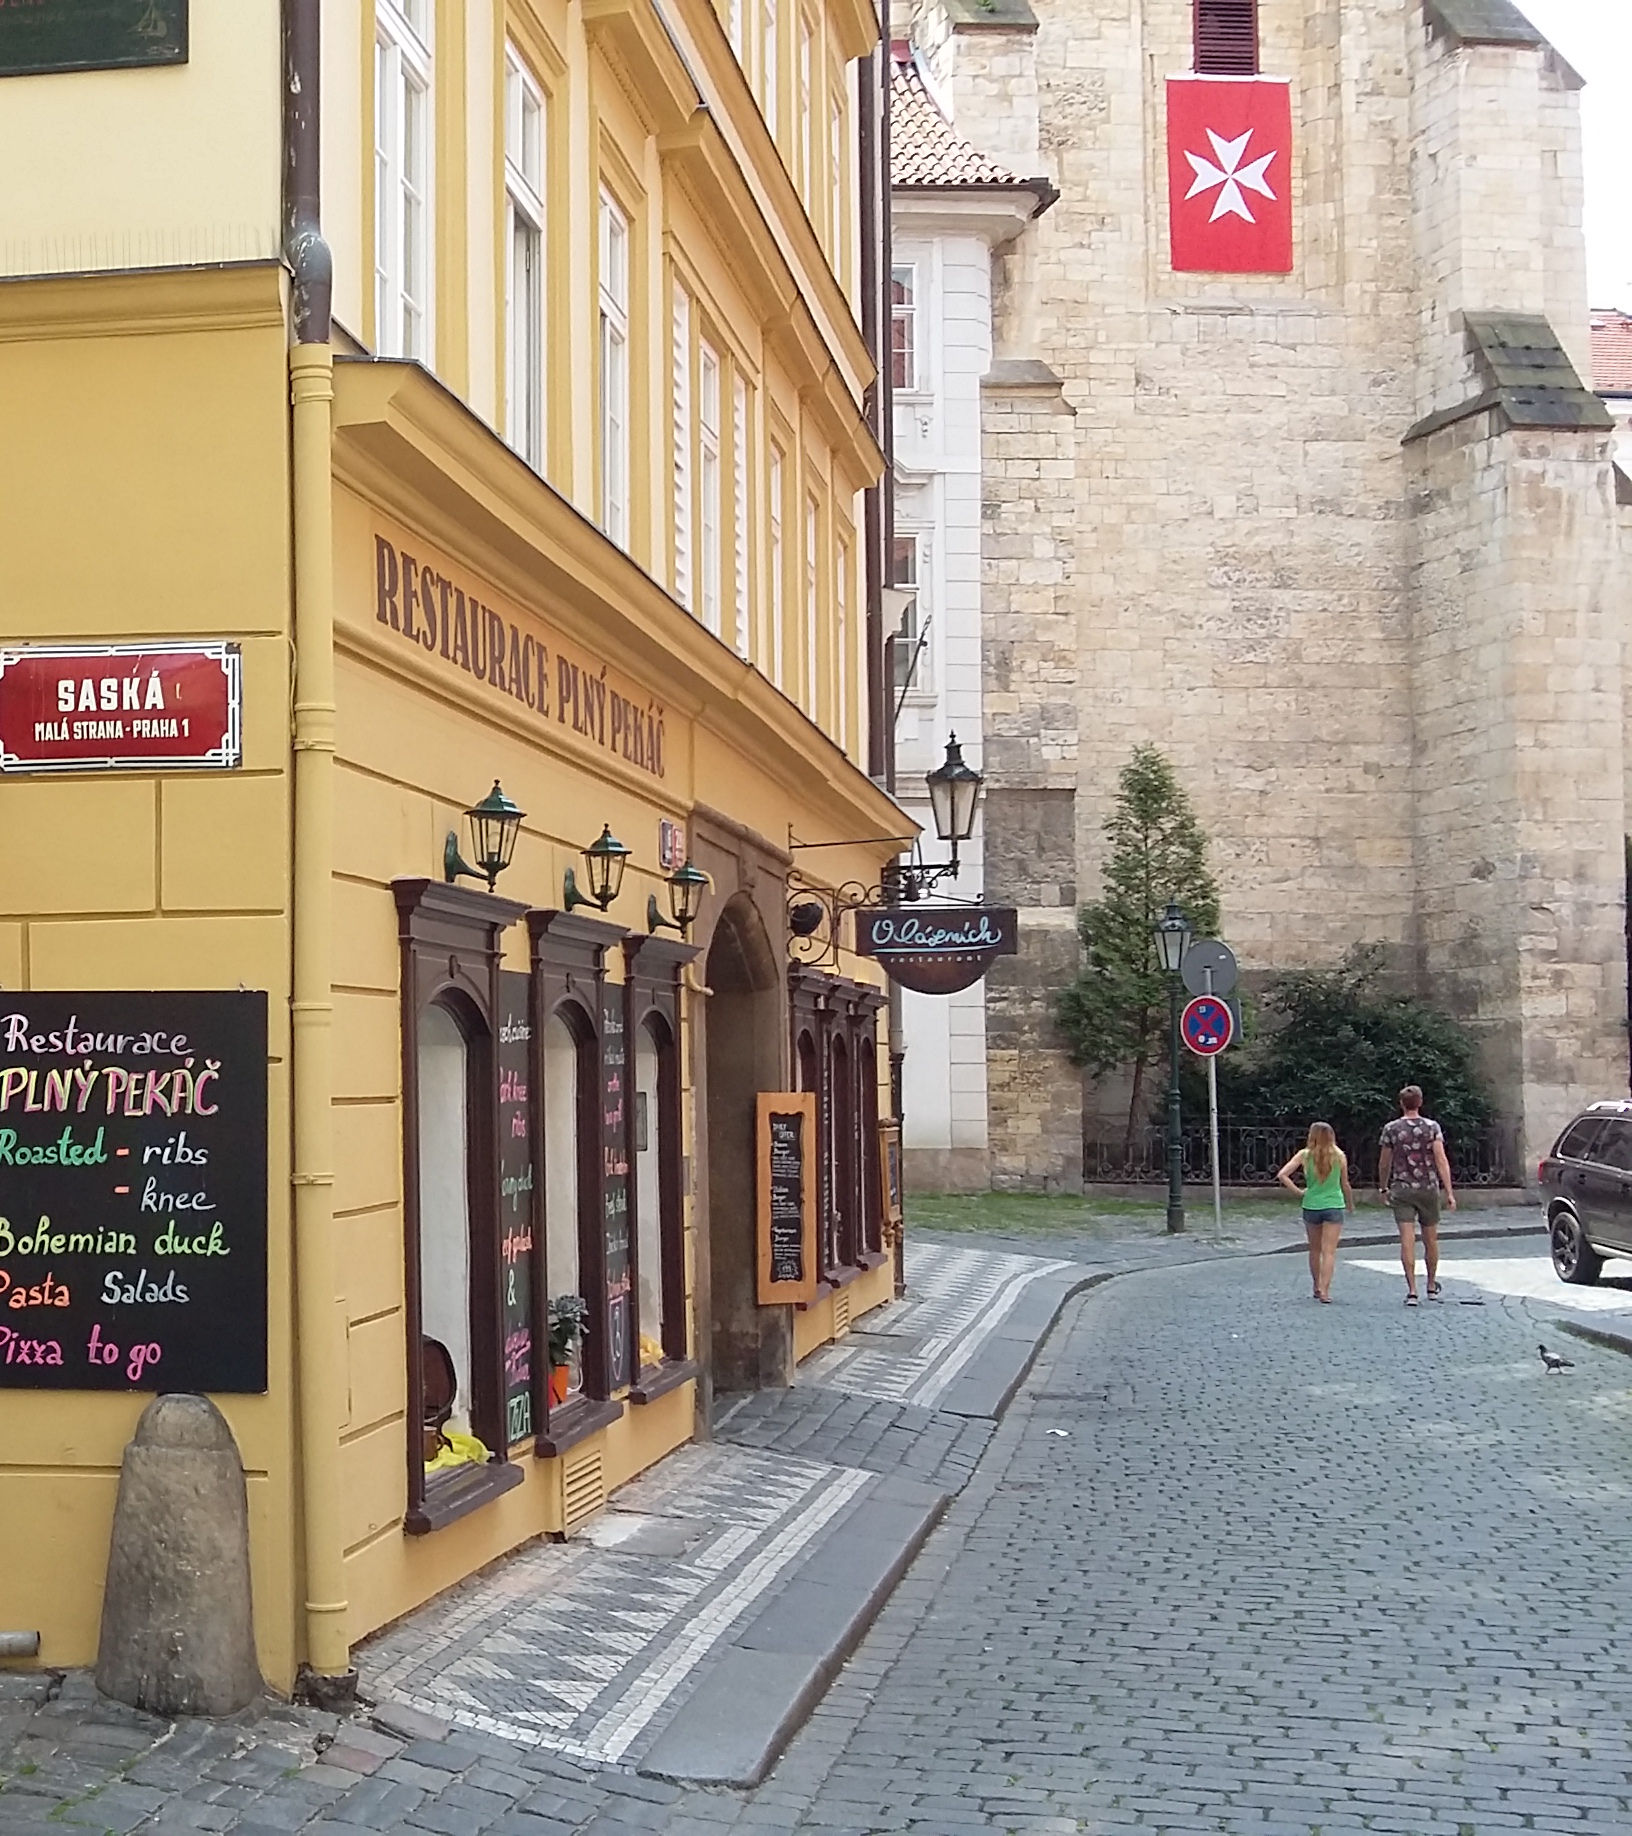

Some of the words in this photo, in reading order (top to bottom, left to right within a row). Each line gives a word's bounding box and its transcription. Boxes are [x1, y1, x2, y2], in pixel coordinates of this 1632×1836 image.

[374, 533, 550, 719] RESTAURACE
[556, 654, 608, 746] PLNÝ
[609, 690, 666, 780] PEKÁČ
[58, 670, 165, 712] SASKÁ
[34, 717, 70, 741] MALÁ
[182, 718, 190, 738] 1
[889, 954, 982, 963] restaurant
[0, 1013, 195, 1055] Restaurace
[103, 1057, 221, 1117] PEKÁČ
[142, 1131, 209, 1165] ribs
[140, 1176, 216, 1213] knee
[154, 1219, 231, 1256] duck
[100, 1268, 190, 1305] Salads
[507, 1268, 517, 1306] &
[87, 1323, 119, 1365] to
[127, 1340, 163, 1381] go
[508, 1390, 532, 1442] IZZA
